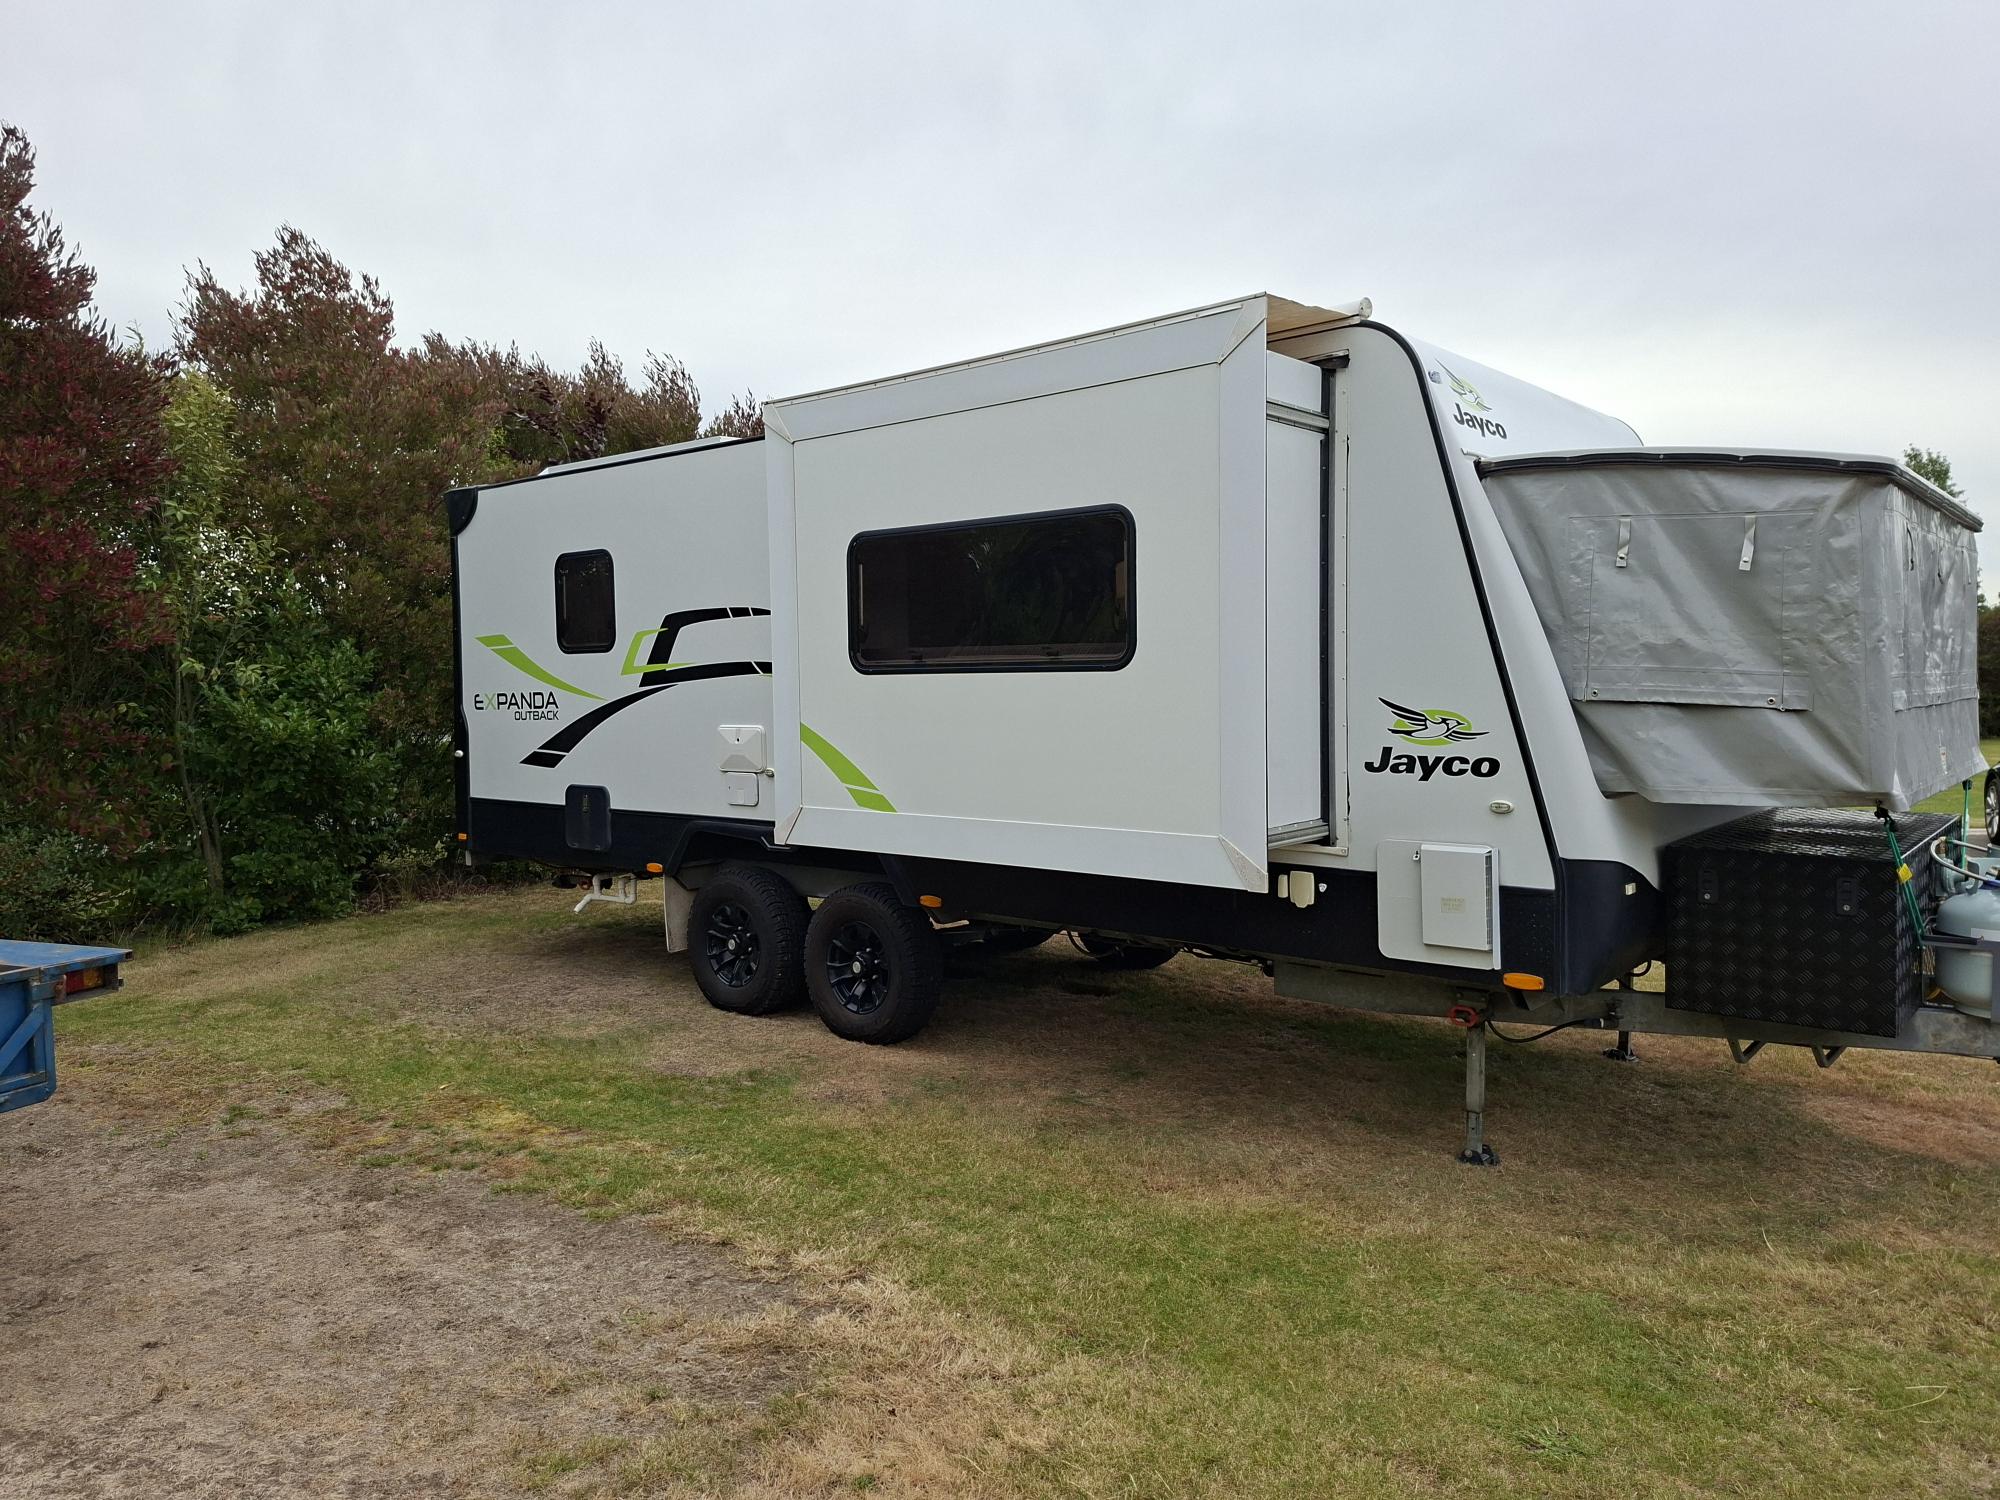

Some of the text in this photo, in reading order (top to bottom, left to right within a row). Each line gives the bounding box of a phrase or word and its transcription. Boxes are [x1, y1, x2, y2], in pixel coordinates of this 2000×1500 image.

[1453, 402, 1508, 440] Jayco
[474, 691, 559, 710] EXPANDA
[514, 710, 560, 721] OUTBACK
[1364, 746, 1500, 782] Jayco
